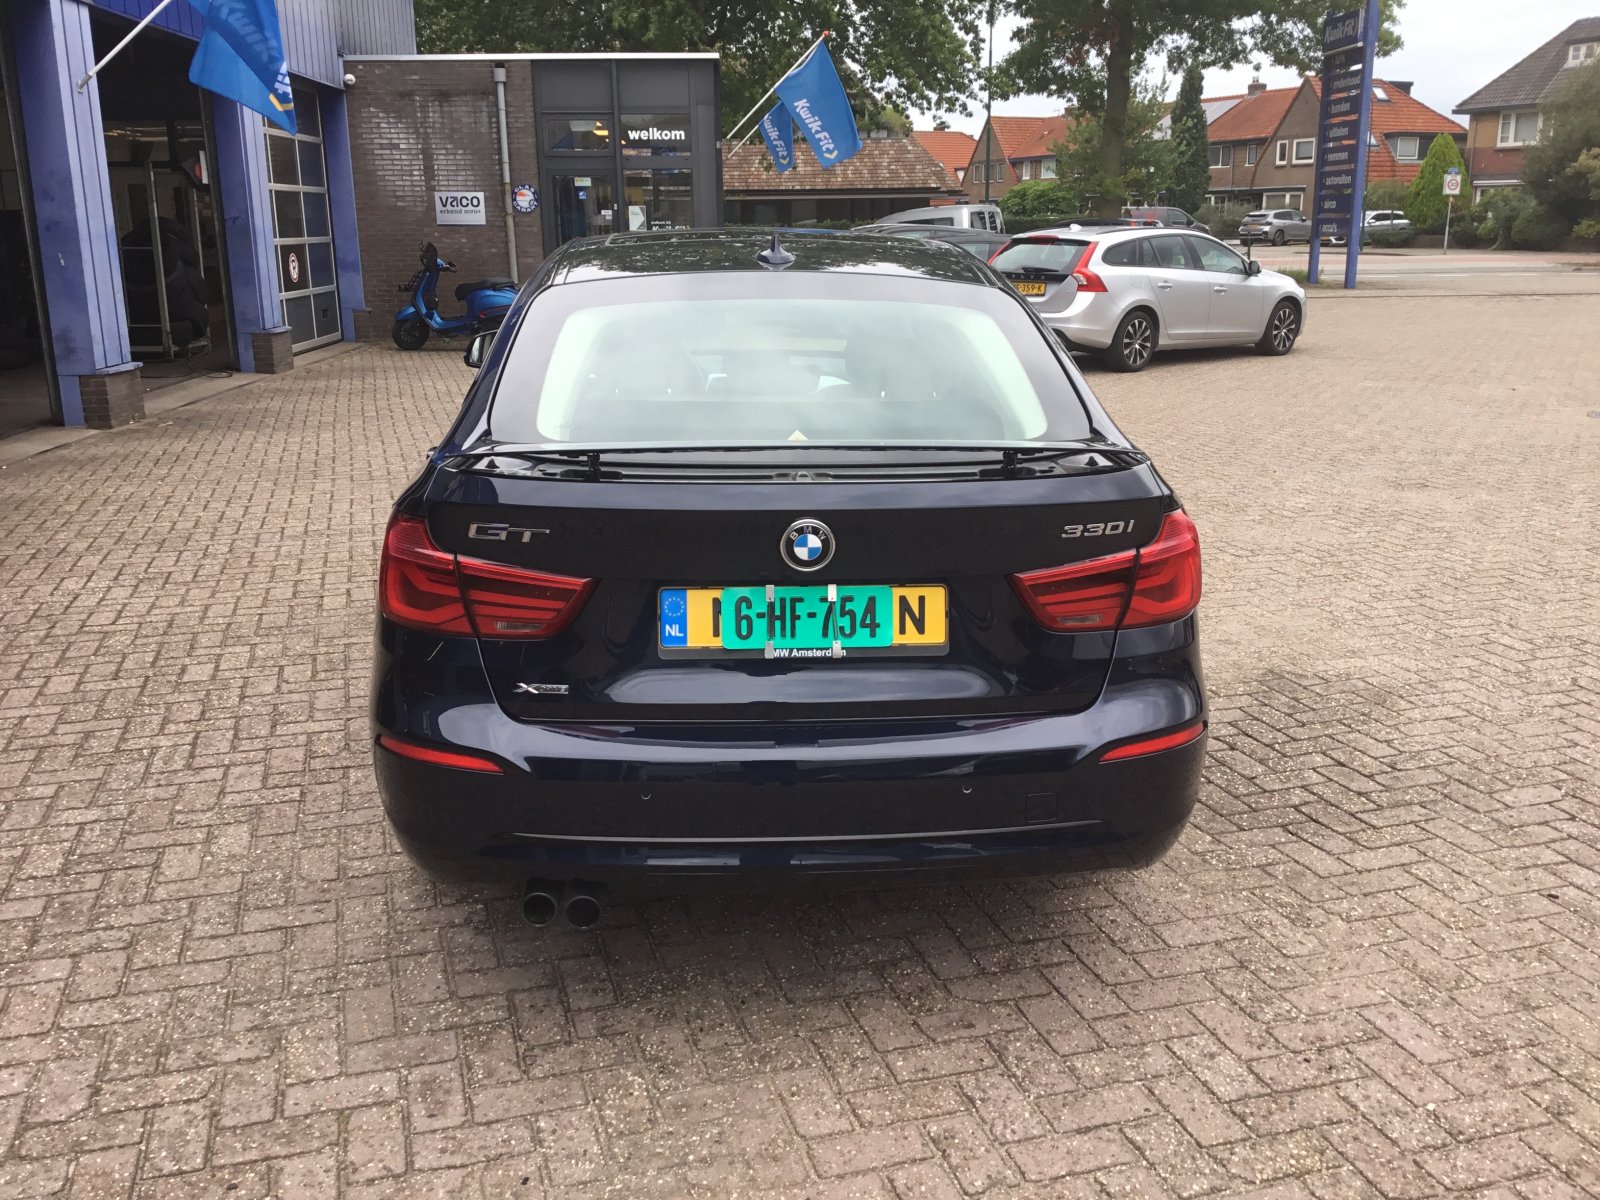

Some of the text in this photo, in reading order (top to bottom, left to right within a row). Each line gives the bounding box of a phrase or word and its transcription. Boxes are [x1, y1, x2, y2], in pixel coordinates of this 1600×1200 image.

[1331, 101, 1351, 114] banden
[793, 98, 835, 152] Kwik Fit
[627, 127, 686, 140] welkom
[1329, 126, 1349, 138] uitlaten
[1327, 151, 1349, 162] remmen
[1325, 174, 1352, 186] autoruiten
[515, 184, 535, 193] GLAS
[1323, 199, 1337, 210] airco
[1321, 222, 1338, 233] accu's
[468, 522, 550, 542] GT
[789, 525, 827, 541] BMW
[734, 595, 881, 641] 6-HF-754
[665, 623, 684, 637] NL
[791, 648, 846, 657] Amsterdm
